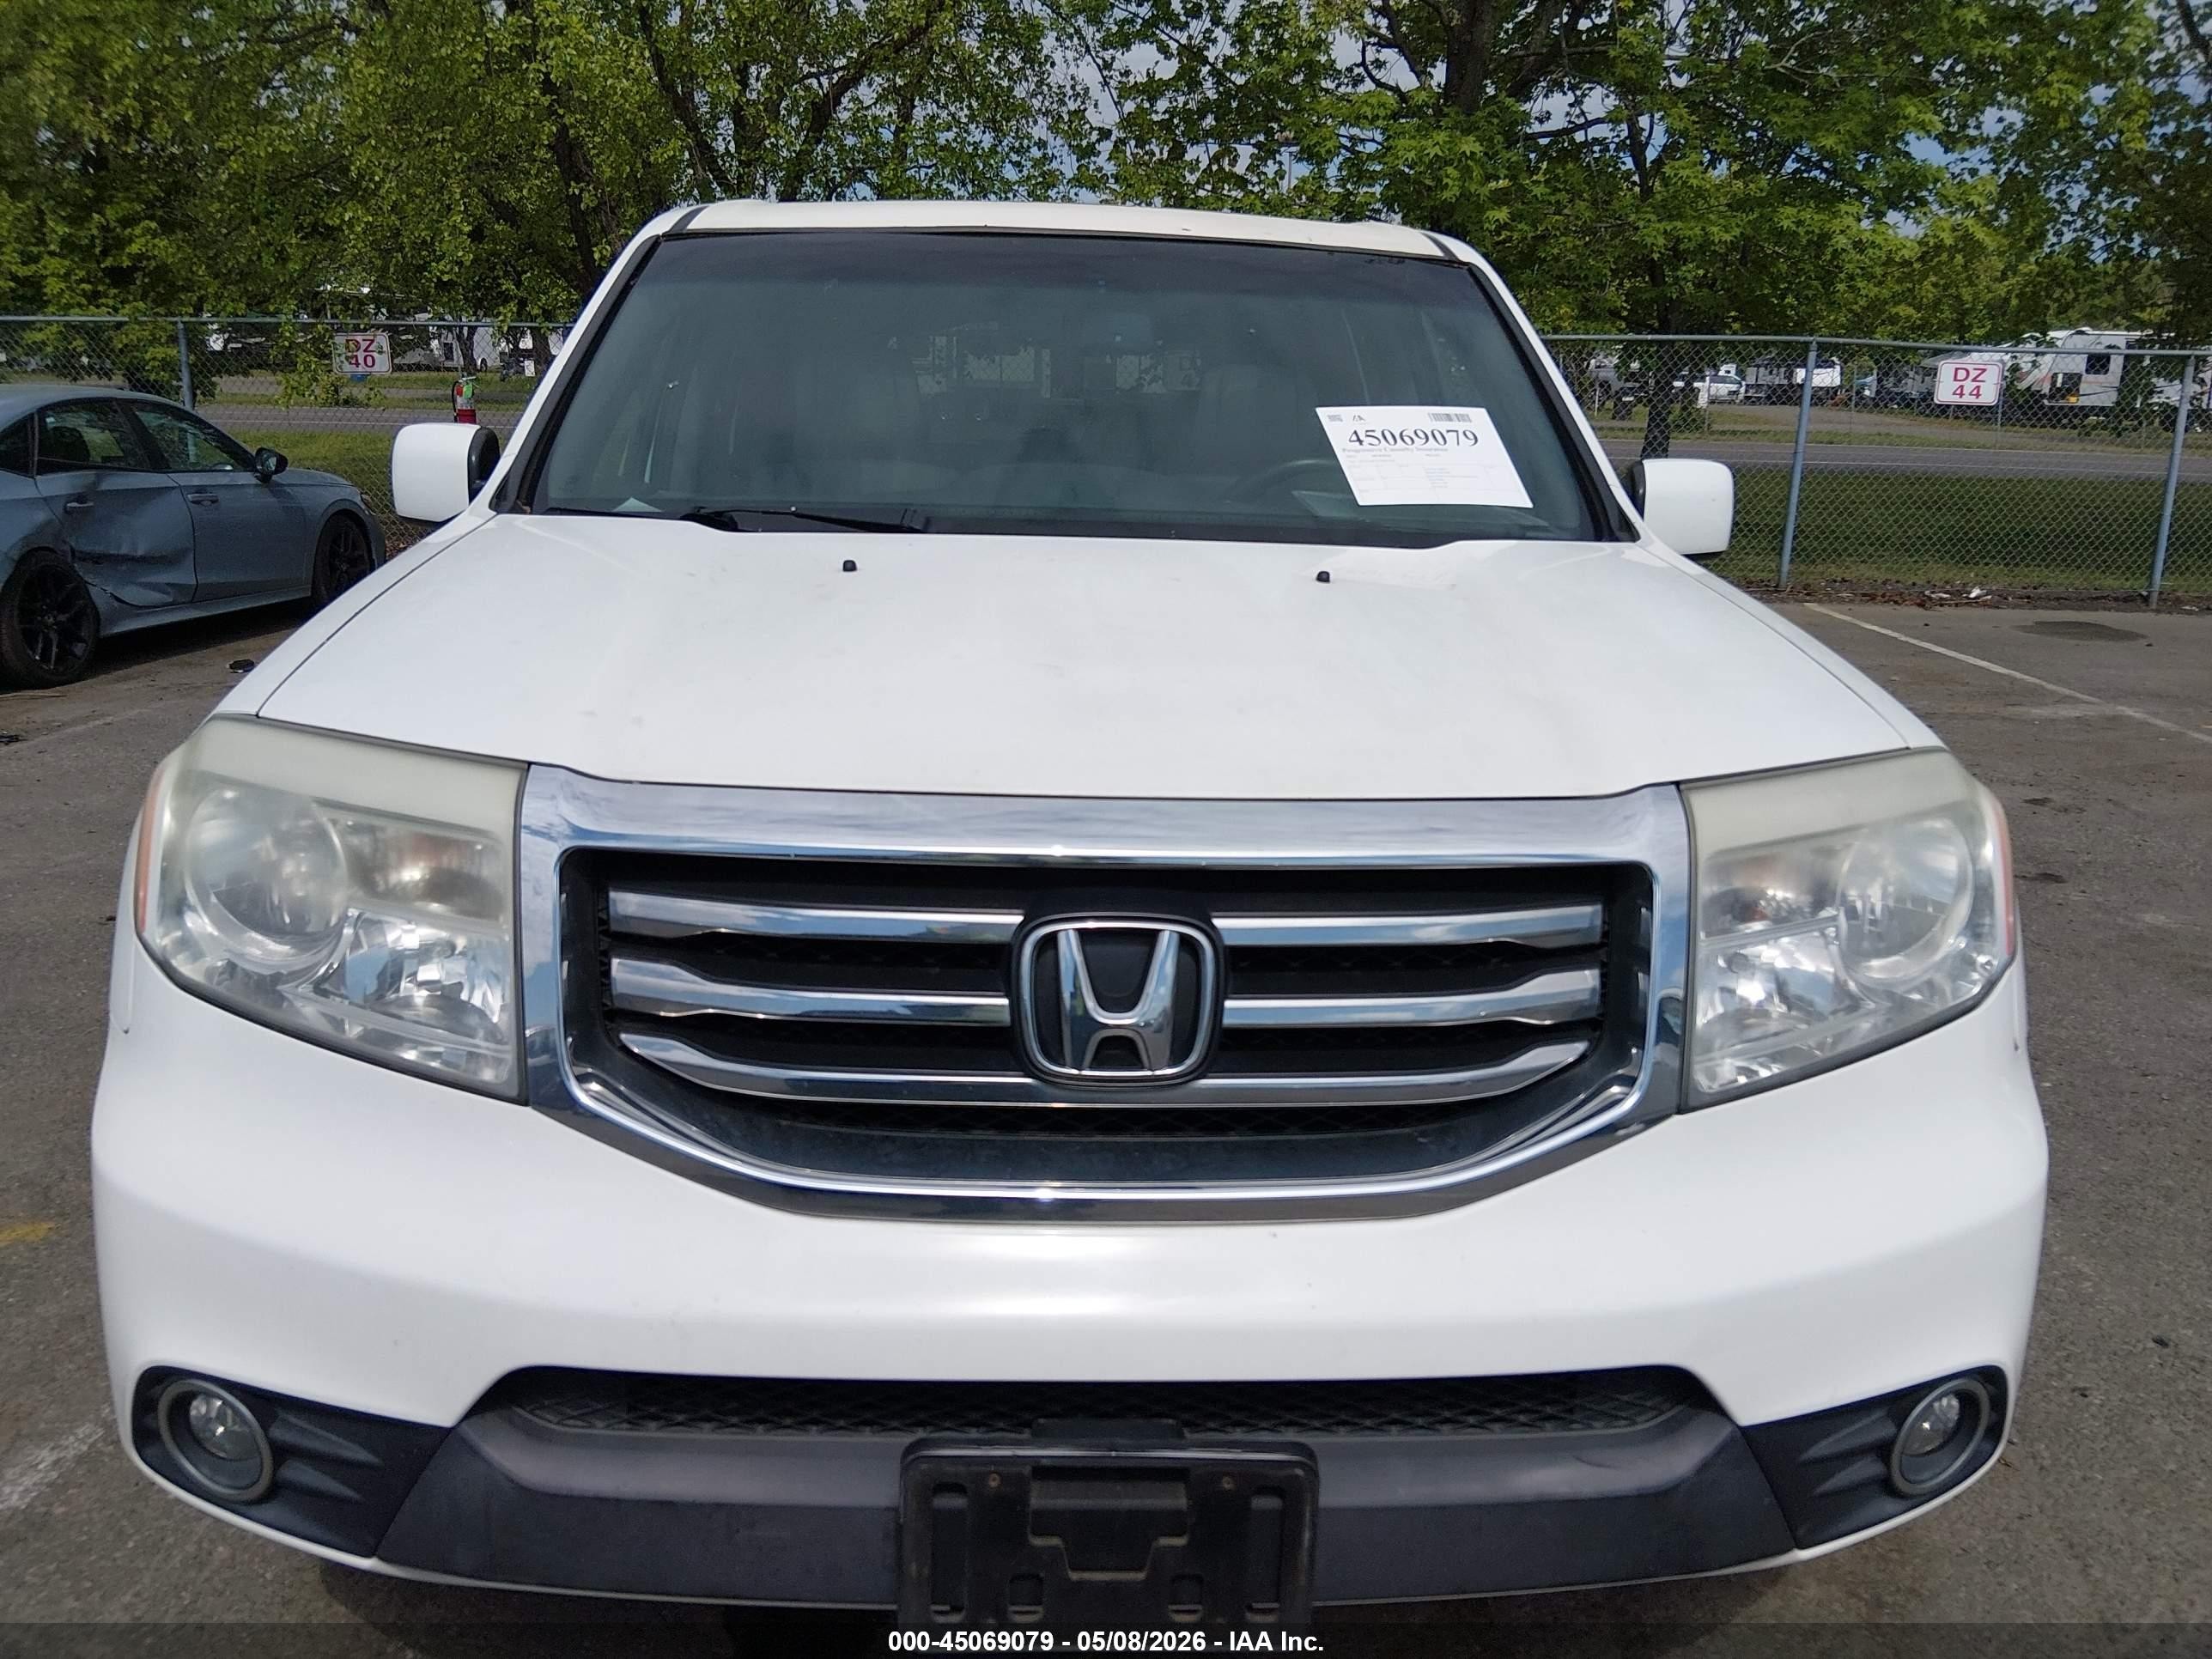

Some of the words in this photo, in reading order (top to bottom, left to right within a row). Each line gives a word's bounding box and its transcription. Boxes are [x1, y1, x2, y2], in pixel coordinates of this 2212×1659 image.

[345, 338, 375, 353] DZ
[348, 354, 376, 368] 40
[1953, 367, 1987, 383] DZ
[1952, 385, 1983, 399] 44
[1348, 428, 1479, 447] 45069079
